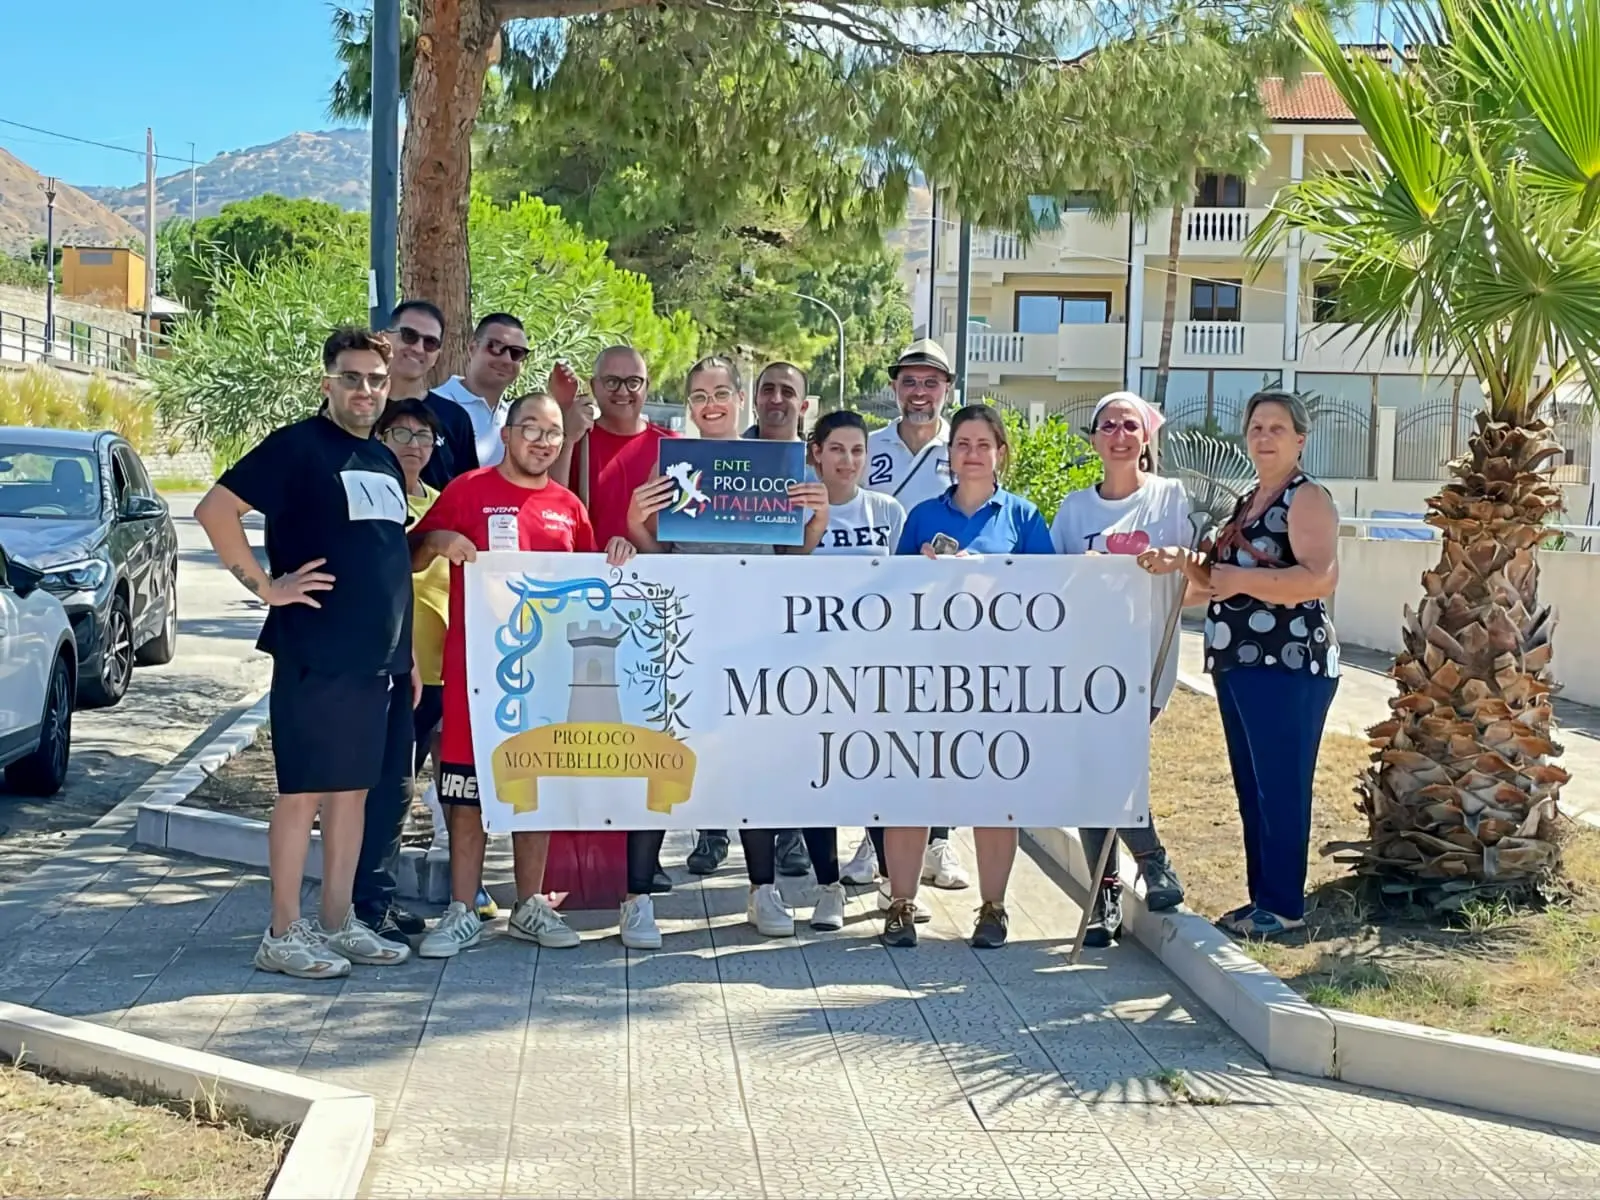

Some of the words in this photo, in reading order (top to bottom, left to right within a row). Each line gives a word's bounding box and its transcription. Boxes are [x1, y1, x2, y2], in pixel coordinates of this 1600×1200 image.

[714, 459, 751, 472] ENTE
[869, 453, 893, 485] 2
[713, 476, 746, 492] PRO
[751, 477, 798, 496] LOCO
[755, 515, 797, 524] CALABRIA
[783, 593, 892, 634] PRO
[909, 591, 1066, 633] LOCO
[722, 664, 1127, 716] MONTEBELLO
[504, 751, 620, 769] MONTEBELLO
[623, 752, 684, 771] JONICO
[810, 729, 1030, 789] JONICO
